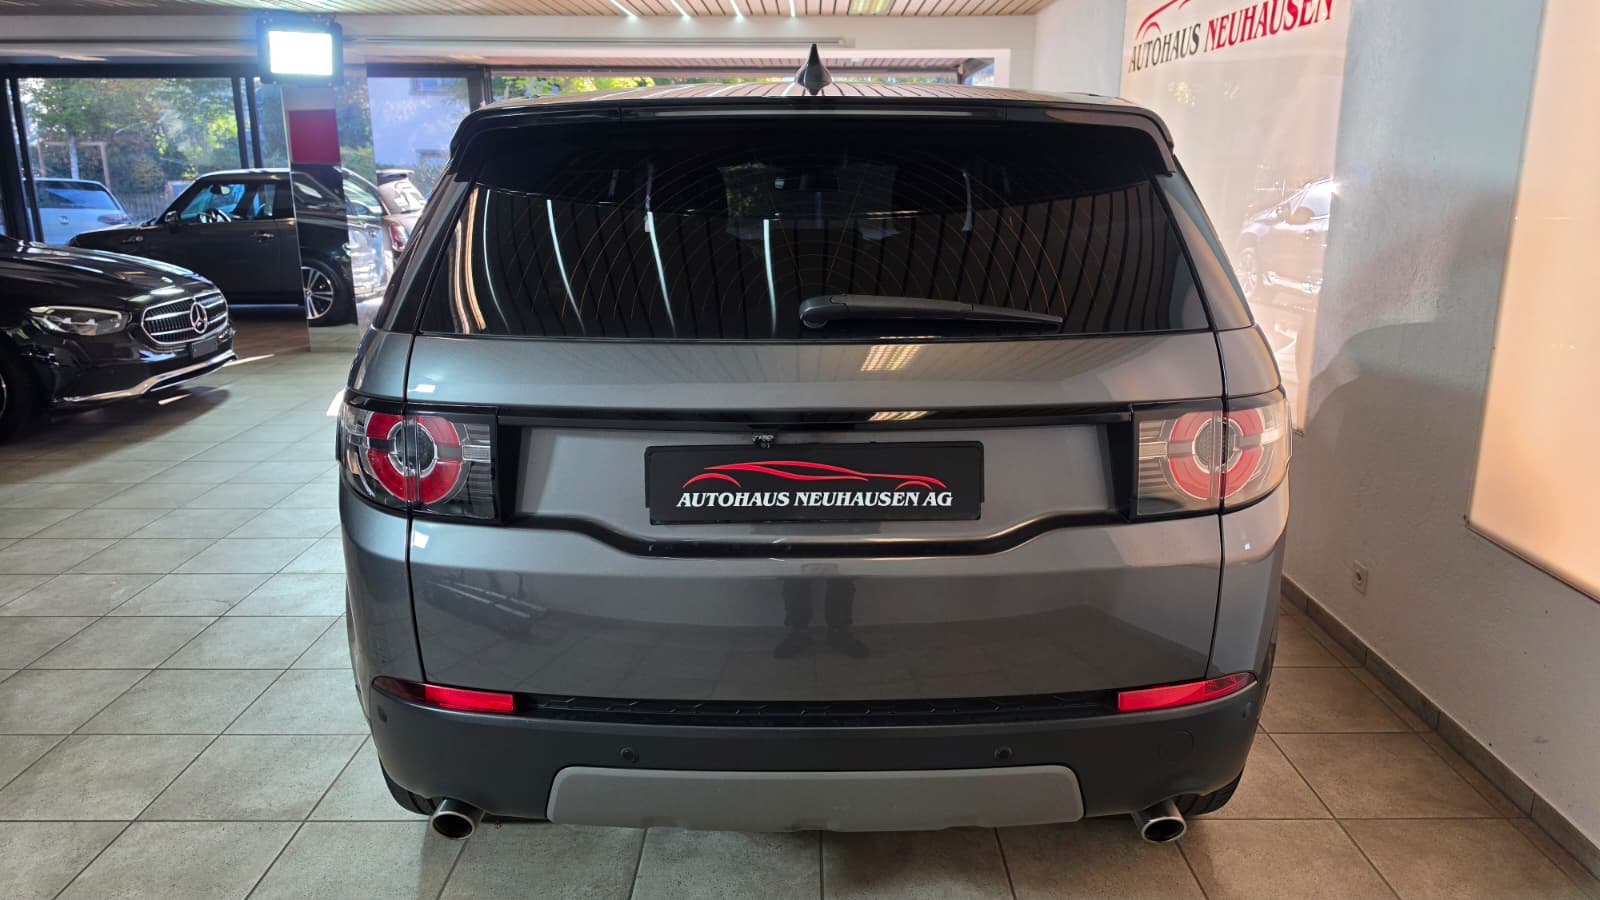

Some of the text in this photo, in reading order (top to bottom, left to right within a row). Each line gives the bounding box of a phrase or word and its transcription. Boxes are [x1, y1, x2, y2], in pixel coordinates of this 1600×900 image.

[1128, 24, 1200, 73] AUTOHAUS
[676, 491, 953, 508] AUTOHAUS NEUHAUSEN AG
